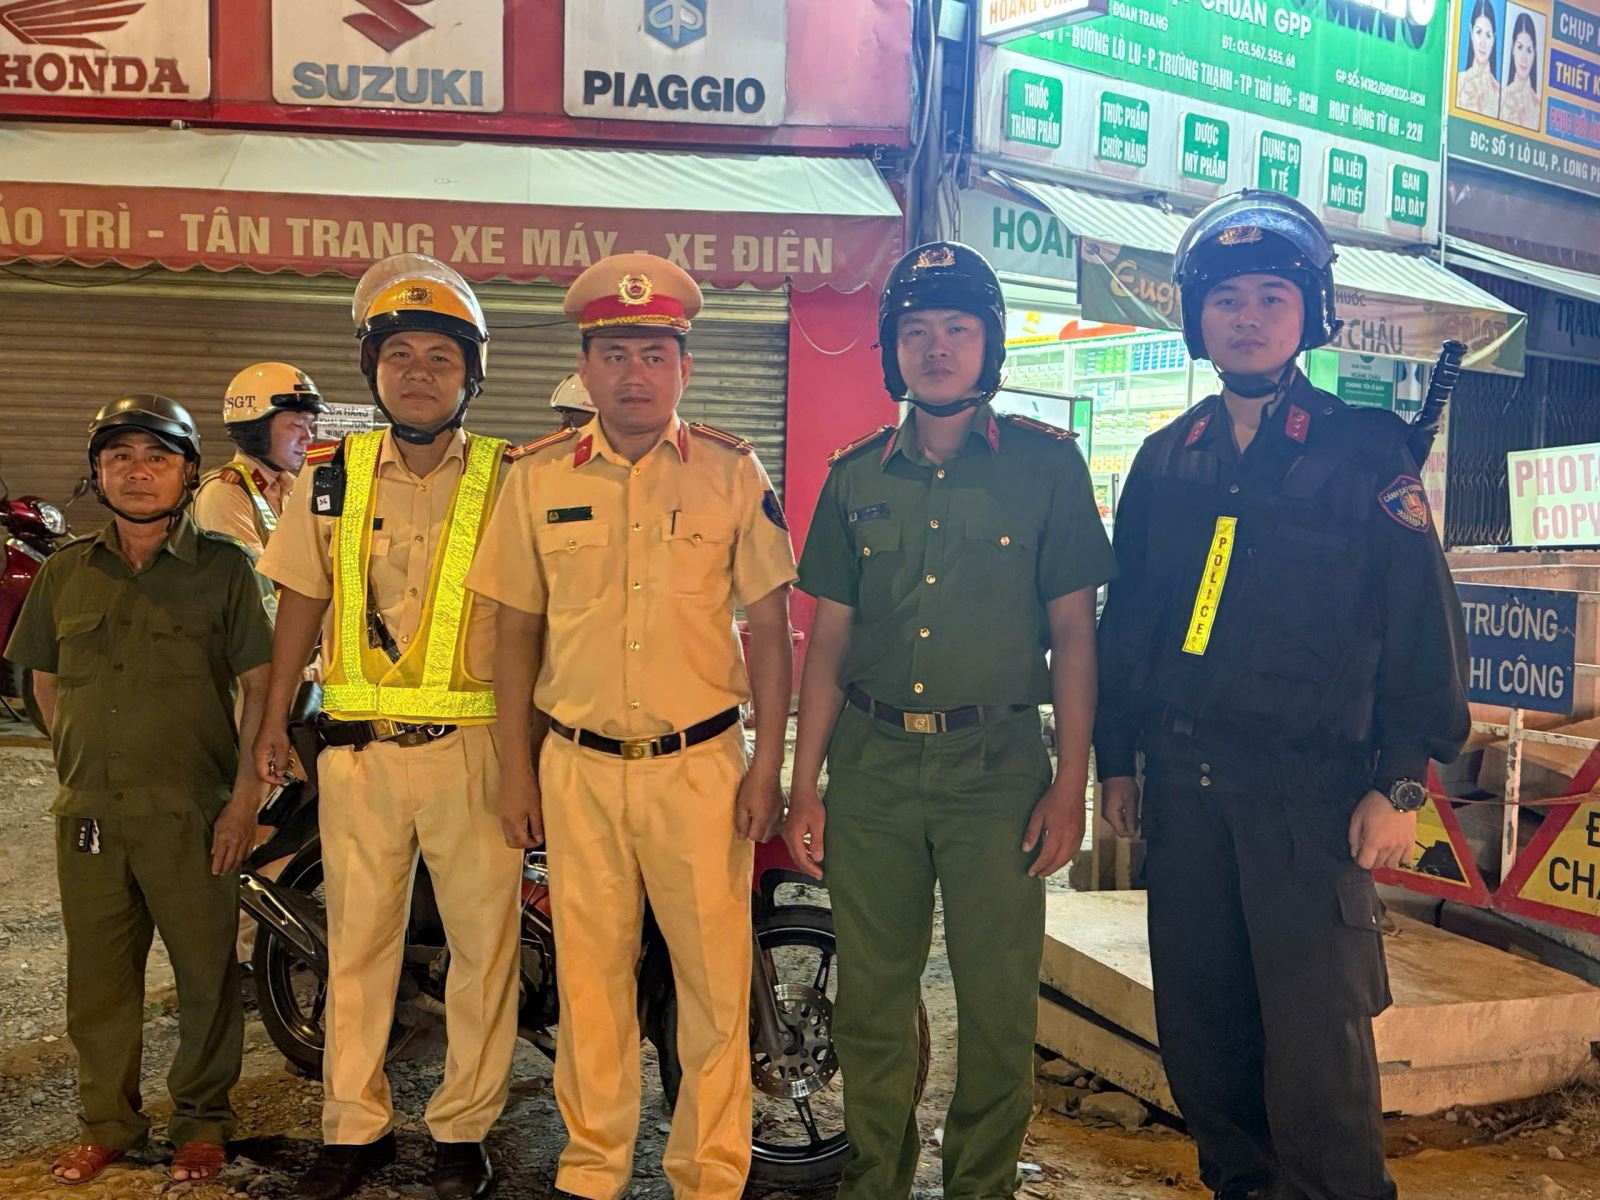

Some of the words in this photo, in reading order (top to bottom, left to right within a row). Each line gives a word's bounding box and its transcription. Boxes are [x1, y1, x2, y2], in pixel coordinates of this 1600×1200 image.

[1139, 9, 1169, 31] TRANG
[1275, 7, 1312, 39] GPP
[1560, 12, 1594, 45] CHỤP
[0, 52, 189, 94] HONDA
[292, 61, 484, 107] SUZUKI
[1072, 24, 1109, 56] ĐƯỜNG
[1112, 32, 1126, 61] LÒ
[1158, 50, 1199, 82] TRƯỜNG
[1200, 62, 1233, 92] THẠNH
[1240, 74, 1252, 96] TP
[1273, 80, 1292, 108] ĐỨC
[1298, 91, 1319, 115] HCM
[1556, 61, 1590, 92] THIẾT
[583, 70, 766, 115] PIAGGIO
[1024, 78, 1049, 111] THUỐC
[1011, 112, 1037, 143] THÀNH
[1037, 112, 1060, 145] PHẨM
[1102, 101, 1123, 130] THỰC
[1124, 103, 1148, 131] PHẨM
[1328, 99, 1350, 127] HOẠT
[1352, 103, 1375, 131] ĐỘNG
[1406, 121, 1424, 142] 22H
[1101, 135, 1123, 160] CHỨC
[1124, 139, 1147, 164] NĂNG
[1194, 121, 1219, 149] DƯỢC
[1199, 151, 1227, 180] PHẨM
[1262, 136, 1286, 163] DỤNG
[1288, 142, 1300, 170] CỤ
[1333, 156, 1344, 176] DA
[1470, 131, 1489, 152] ĐC:
[1491, 134, 1507, 156] SỐ
[1508, 142, 1515, 159] 1
[1518, 142, 1531, 163] LÒ
[1563, 157, 1588, 179] LONG
[1271, 168, 1278, 190] Y
[1278, 166, 1290, 192] TẾ
[1331, 182, 1345, 206] NỘI
[1347, 185, 1363, 208] TIẾT
[1402, 171, 1420, 192] GAN
[1394, 195, 1406, 217] DẠ
[59, 202, 130, 249] TRÌ
[181, 207, 271, 254] TÂN
[286, 217, 435, 262] TRANG
[450, 226, 504, 265] XE
[523, 222, 618, 268] MÁY
[665, 233, 717, 271] XE
[1335, 289, 1366, 307] HUỐC
[1347, 317, 1403, 355] CHÂU
[1515, 453, 1600, 497] PHOT
[1196, 537, 1227, 635] POLICE
[1462, 596, 1558, 642] TRƯỜNG
[1469, 656, 1492, 690] HI
[1499, 654, 1564, 699] CÔNG
